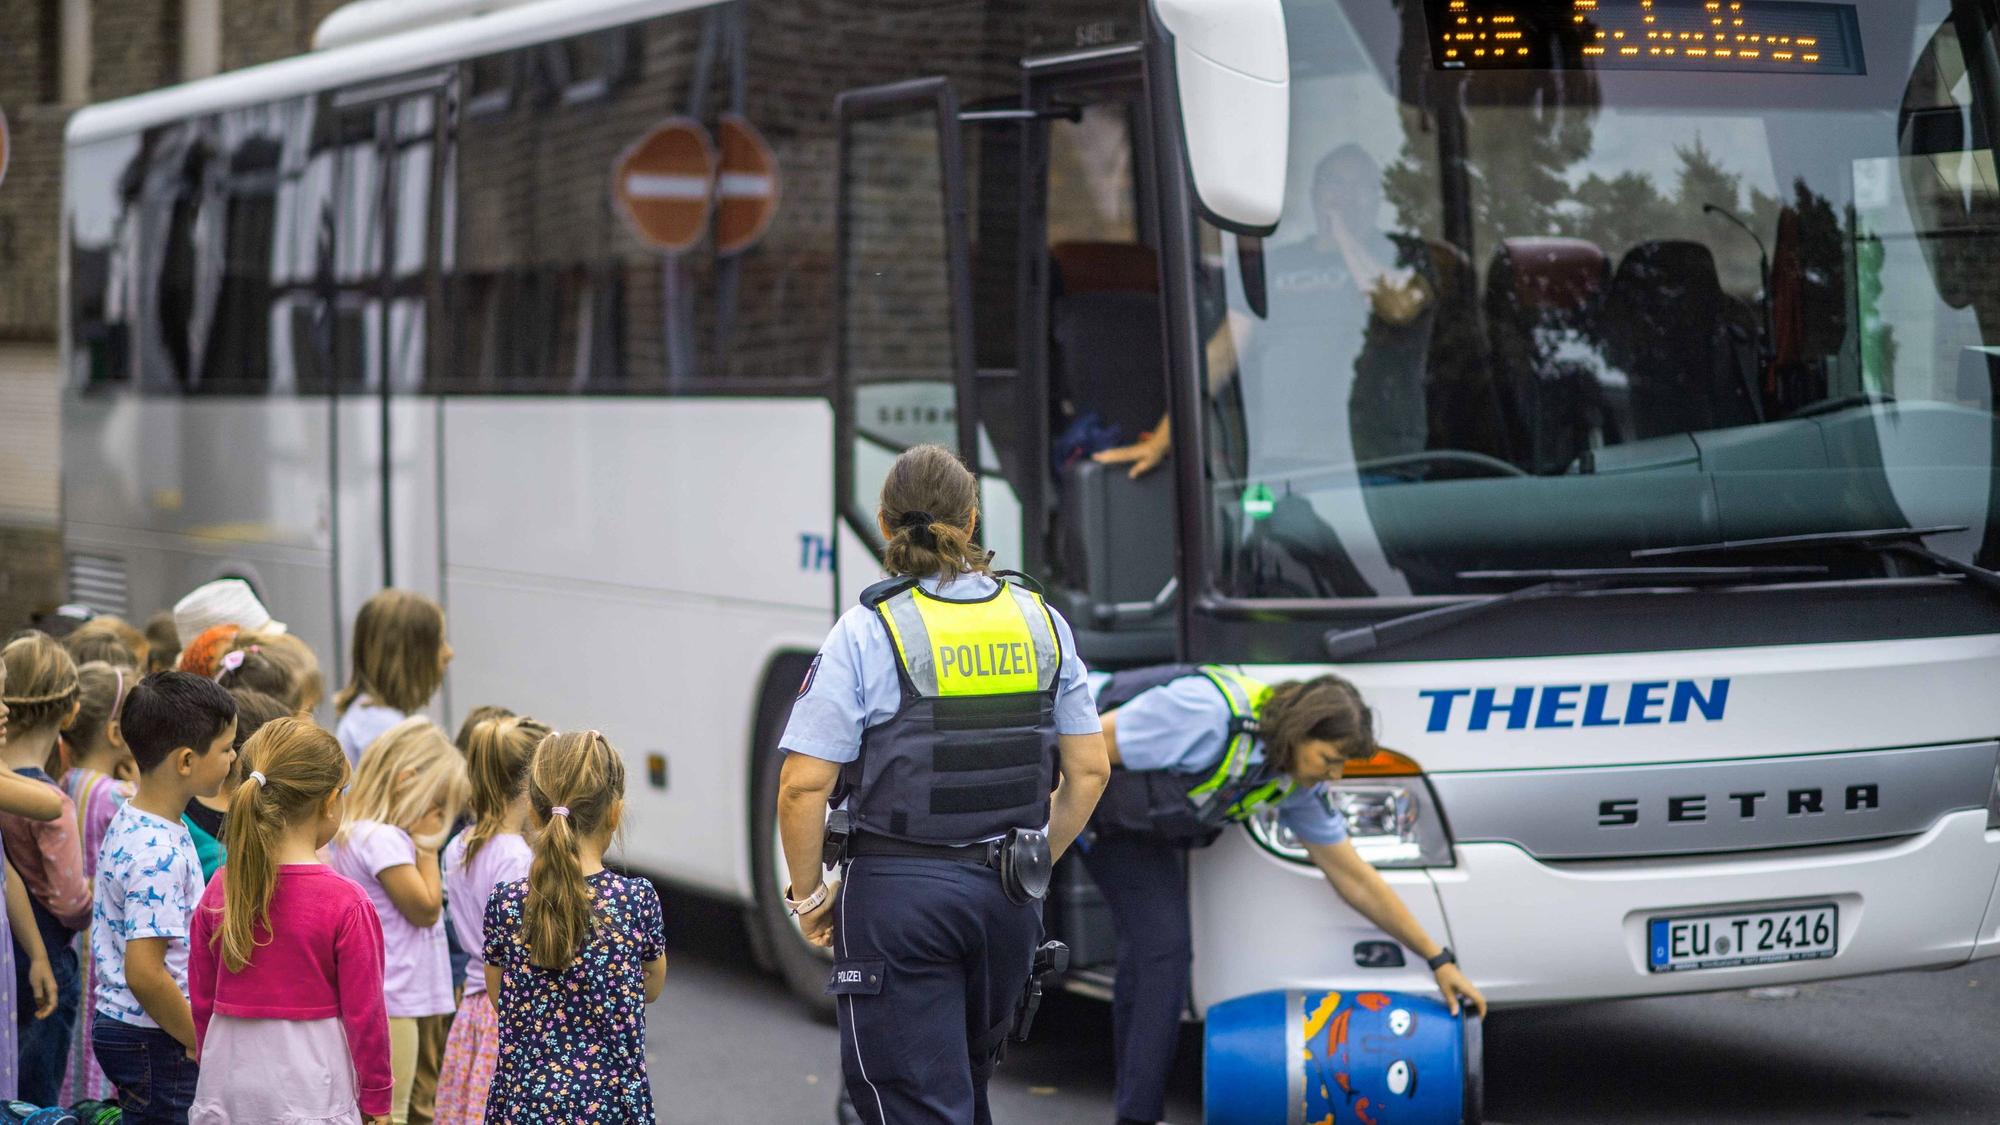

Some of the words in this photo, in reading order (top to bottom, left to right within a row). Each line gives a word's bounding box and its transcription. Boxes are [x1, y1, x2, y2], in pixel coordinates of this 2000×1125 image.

[939, 642, 1033, 678] POLIZEI
[1418, 678, 1731, 733] THELEN
[1597, 784, 1880, 827] SETRA
[1671, 923, 1710, 958] EU
[1731, 920, 1749, 952] T
[1757, 913, 1830, 950] 2416
[837, 970, 862, 983] POLIZEI
